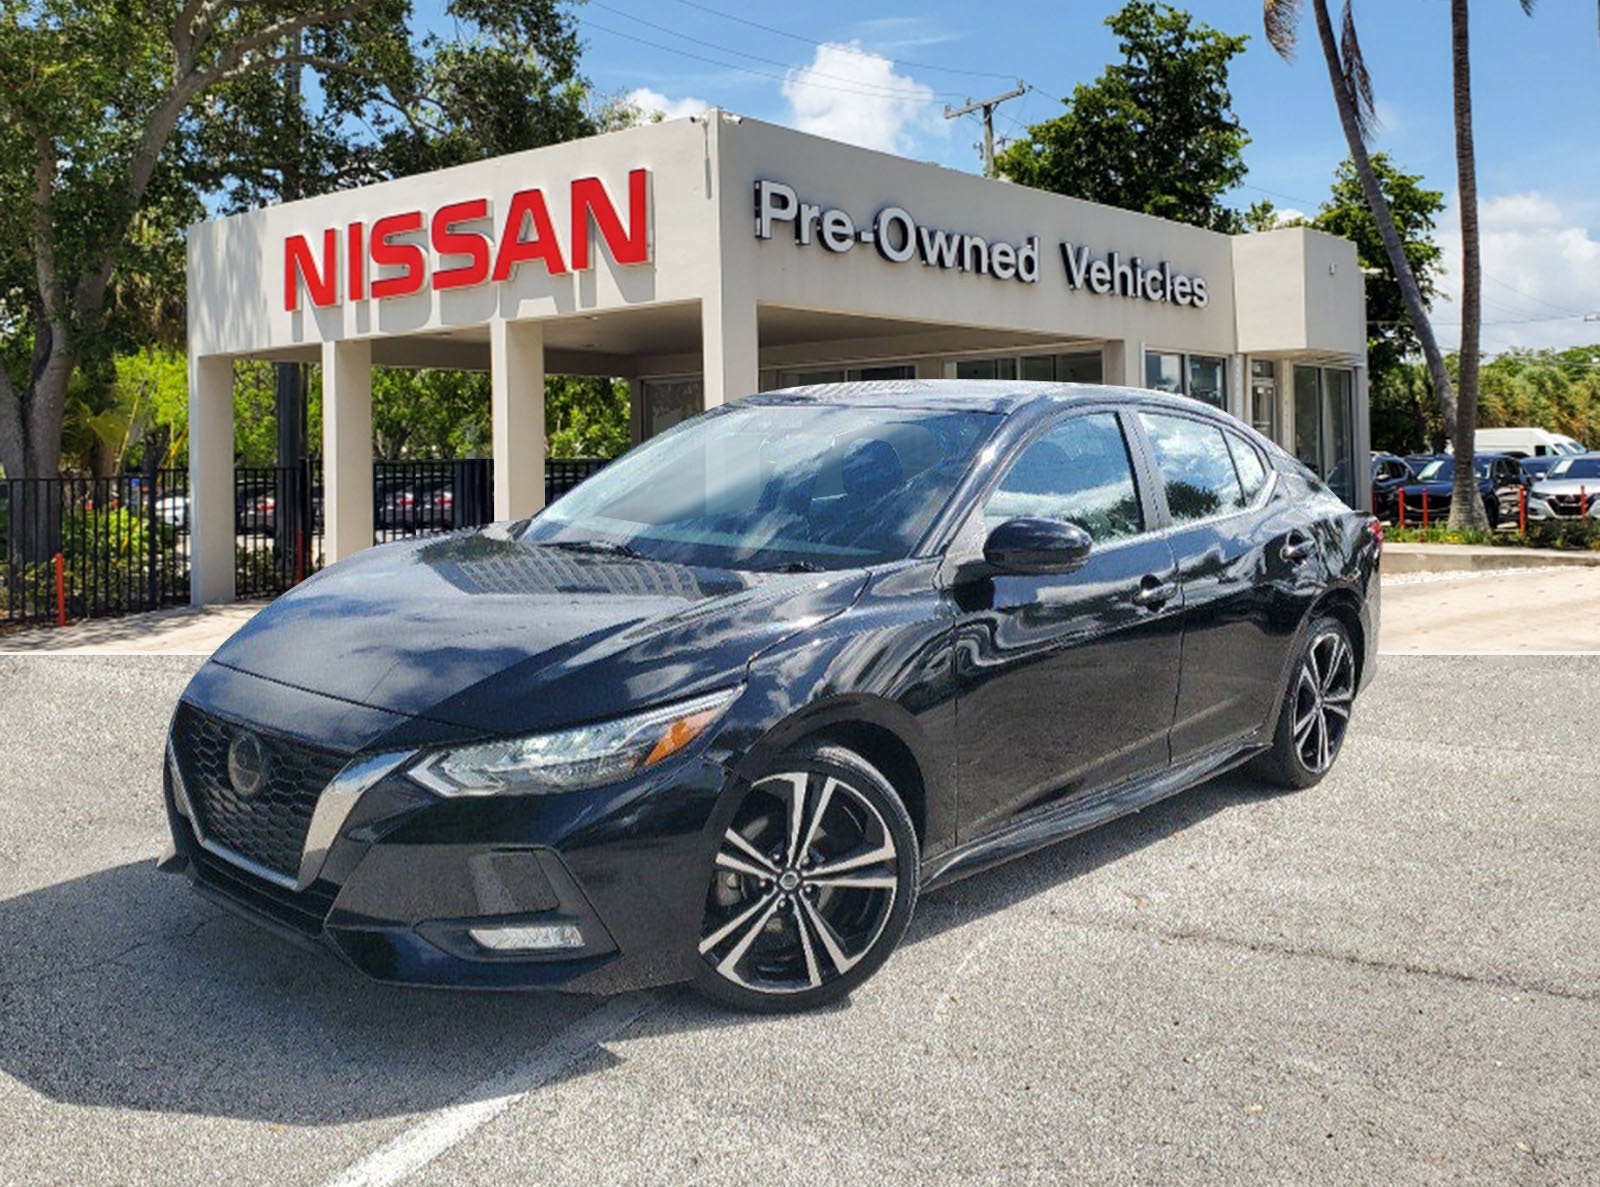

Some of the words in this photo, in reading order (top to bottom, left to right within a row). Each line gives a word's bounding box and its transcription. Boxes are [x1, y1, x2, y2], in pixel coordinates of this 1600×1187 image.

[285, 168, 650, 312] NISSAN
[754, 179, 1040, 284] Pre-Owned
[1060, 241, 1209, 308] Vehicles
